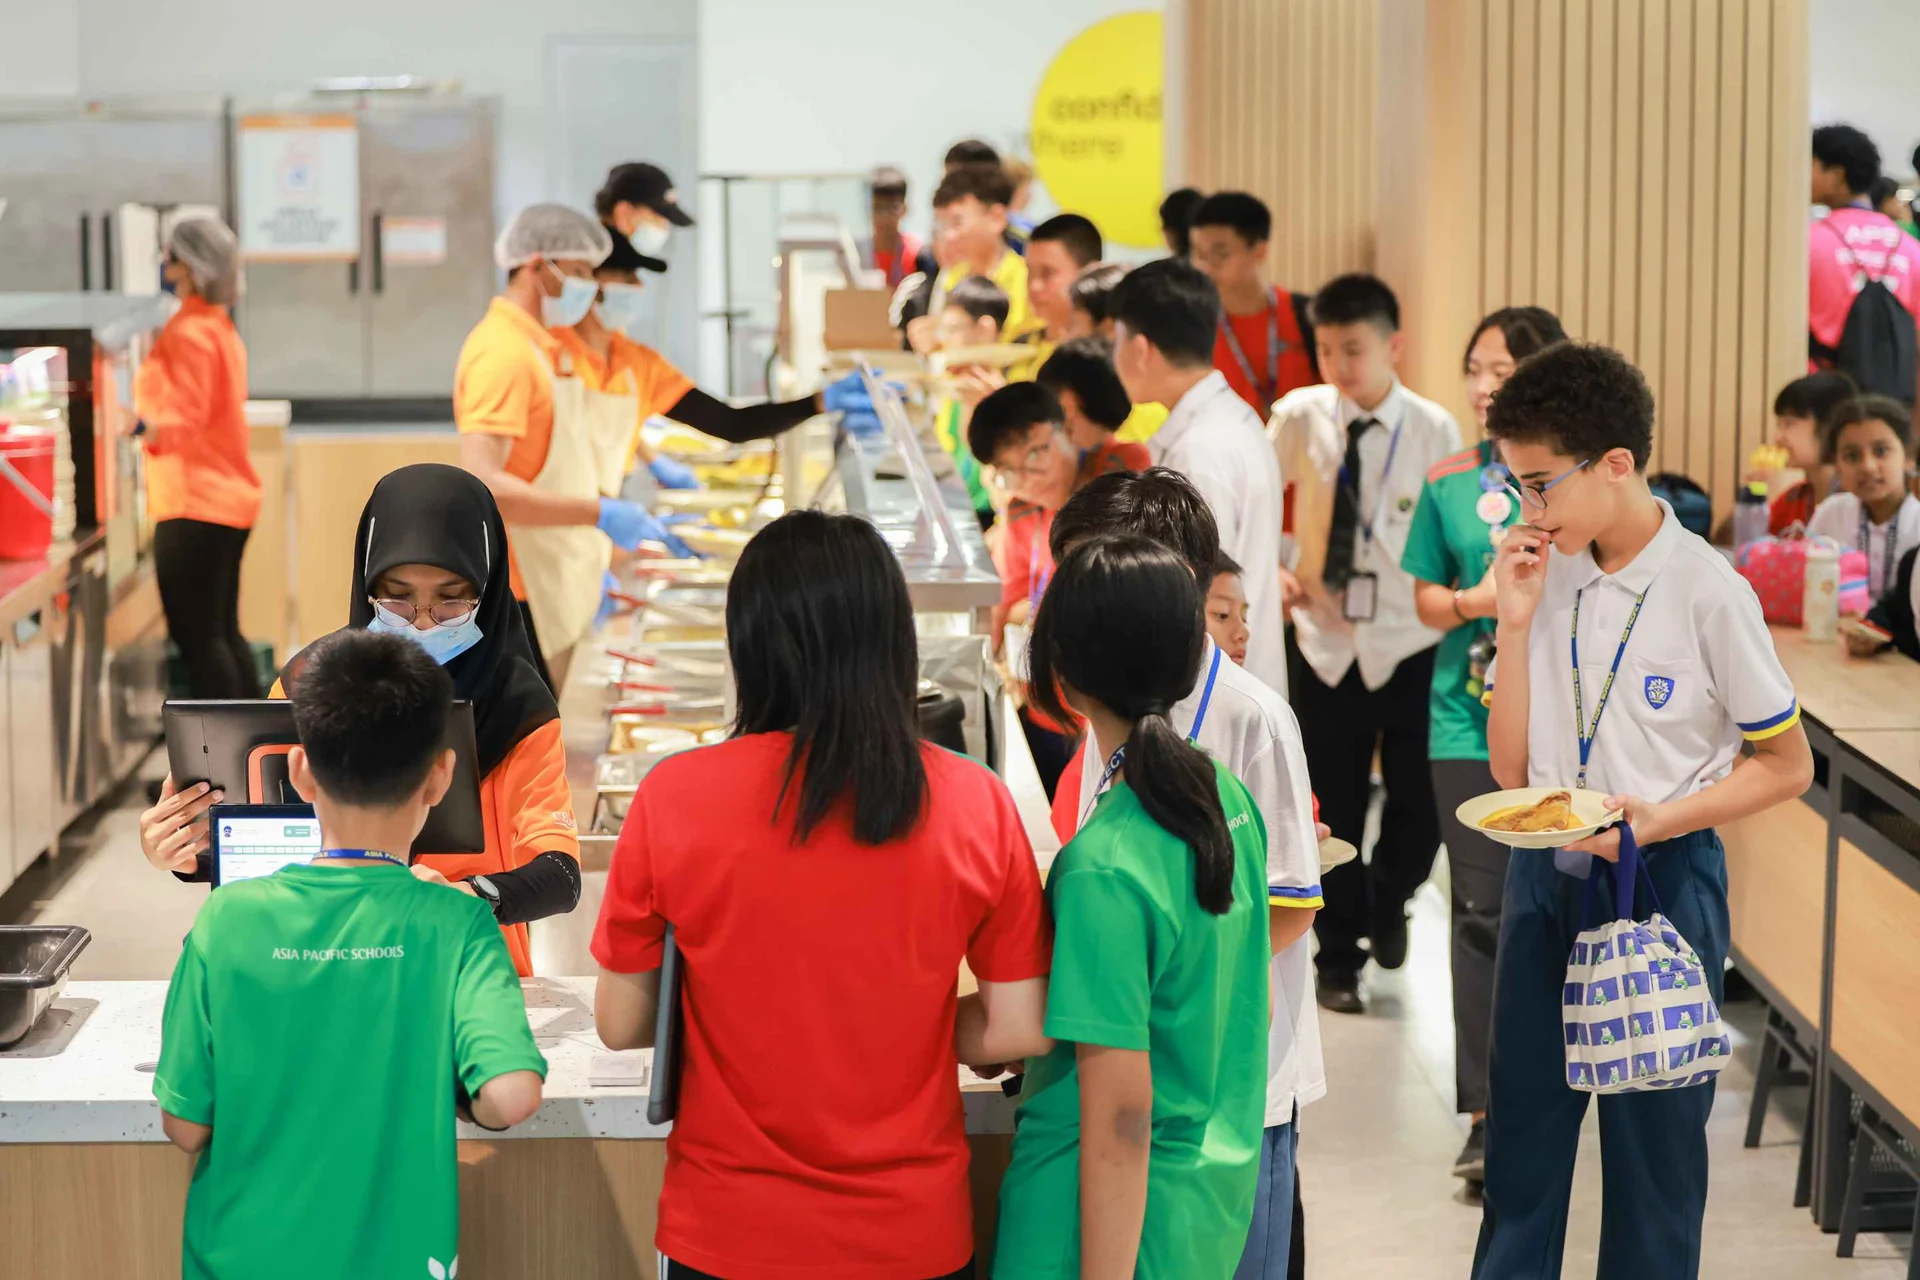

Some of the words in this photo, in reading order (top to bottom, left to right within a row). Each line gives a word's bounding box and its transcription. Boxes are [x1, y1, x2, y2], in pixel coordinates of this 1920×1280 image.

[272, 947, 299, 960] ASIA
[303, 949, 349, 961] PACIFIC
[351, 945, 404, 960] SCHOOLS
